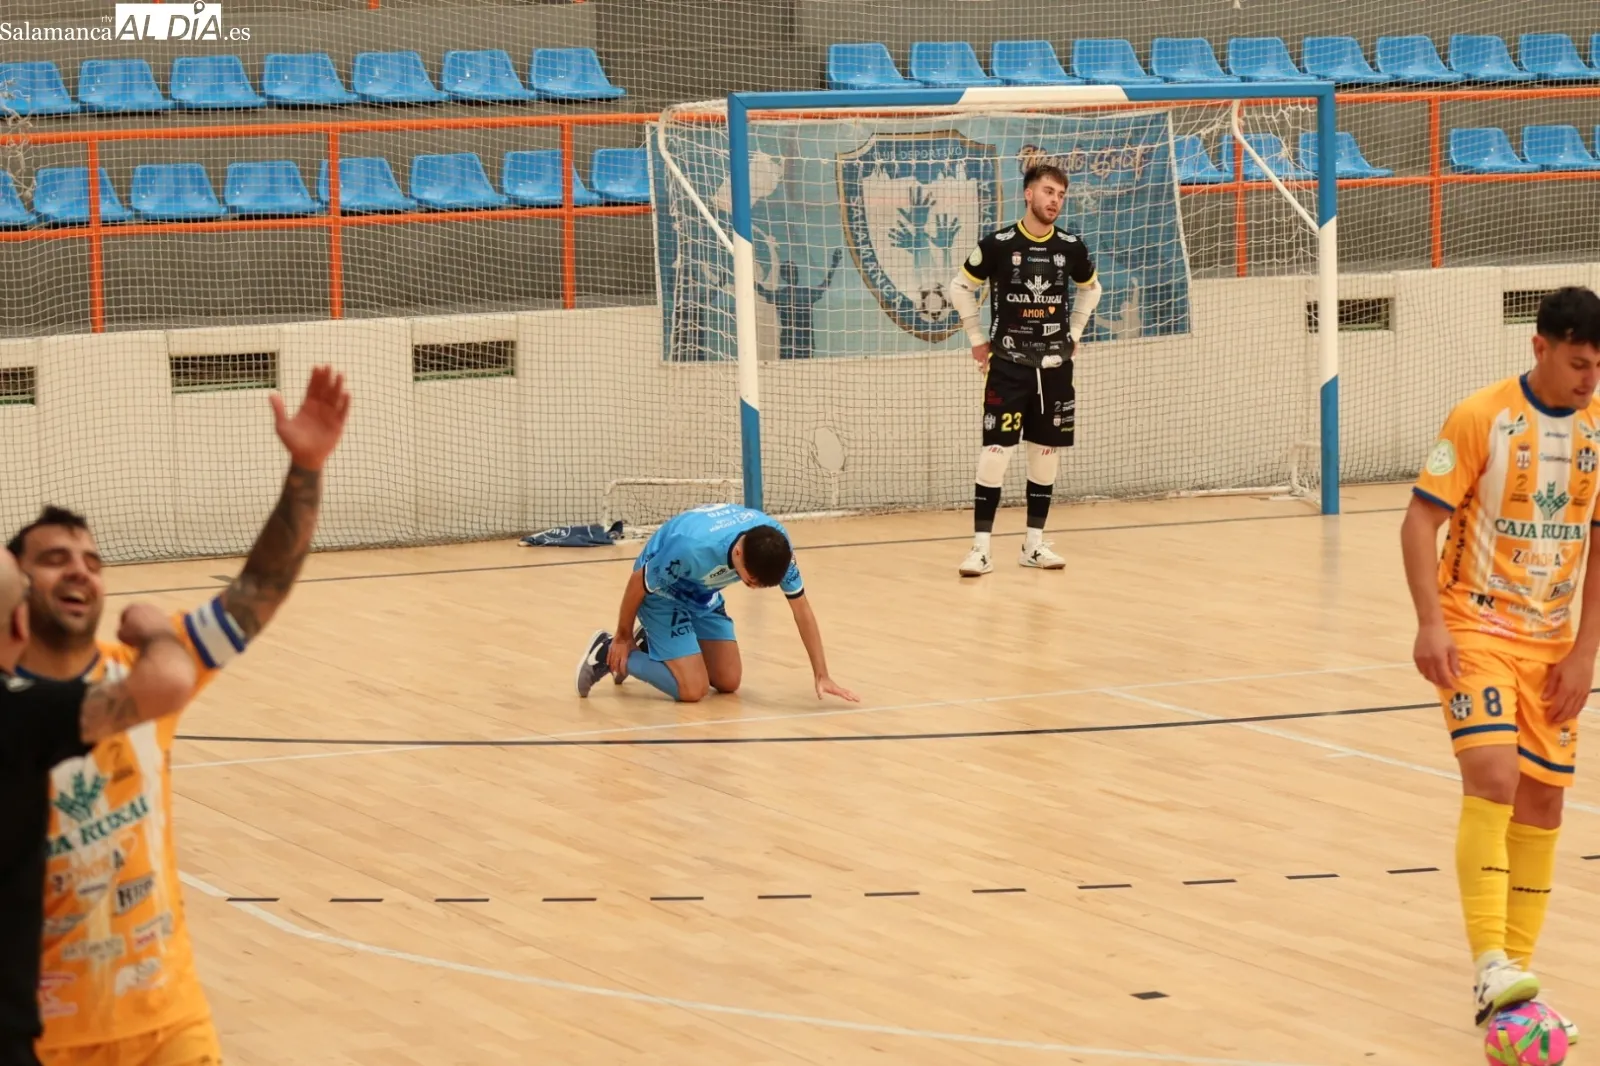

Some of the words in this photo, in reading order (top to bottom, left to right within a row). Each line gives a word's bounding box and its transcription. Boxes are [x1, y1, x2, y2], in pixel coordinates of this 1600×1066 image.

[900, 146, 963, 160] DEPORTIVO
[850, 195, 903, 309] SALAMANCA
[1006, 292, 1031, 303] CAJA
[1033, 294, 1062, 304] RURAL
[1001, 412, 1022, 432] 23
[1495, 518, 1538, 539] CAJA
[1483, 686, 1502, 717] 8
